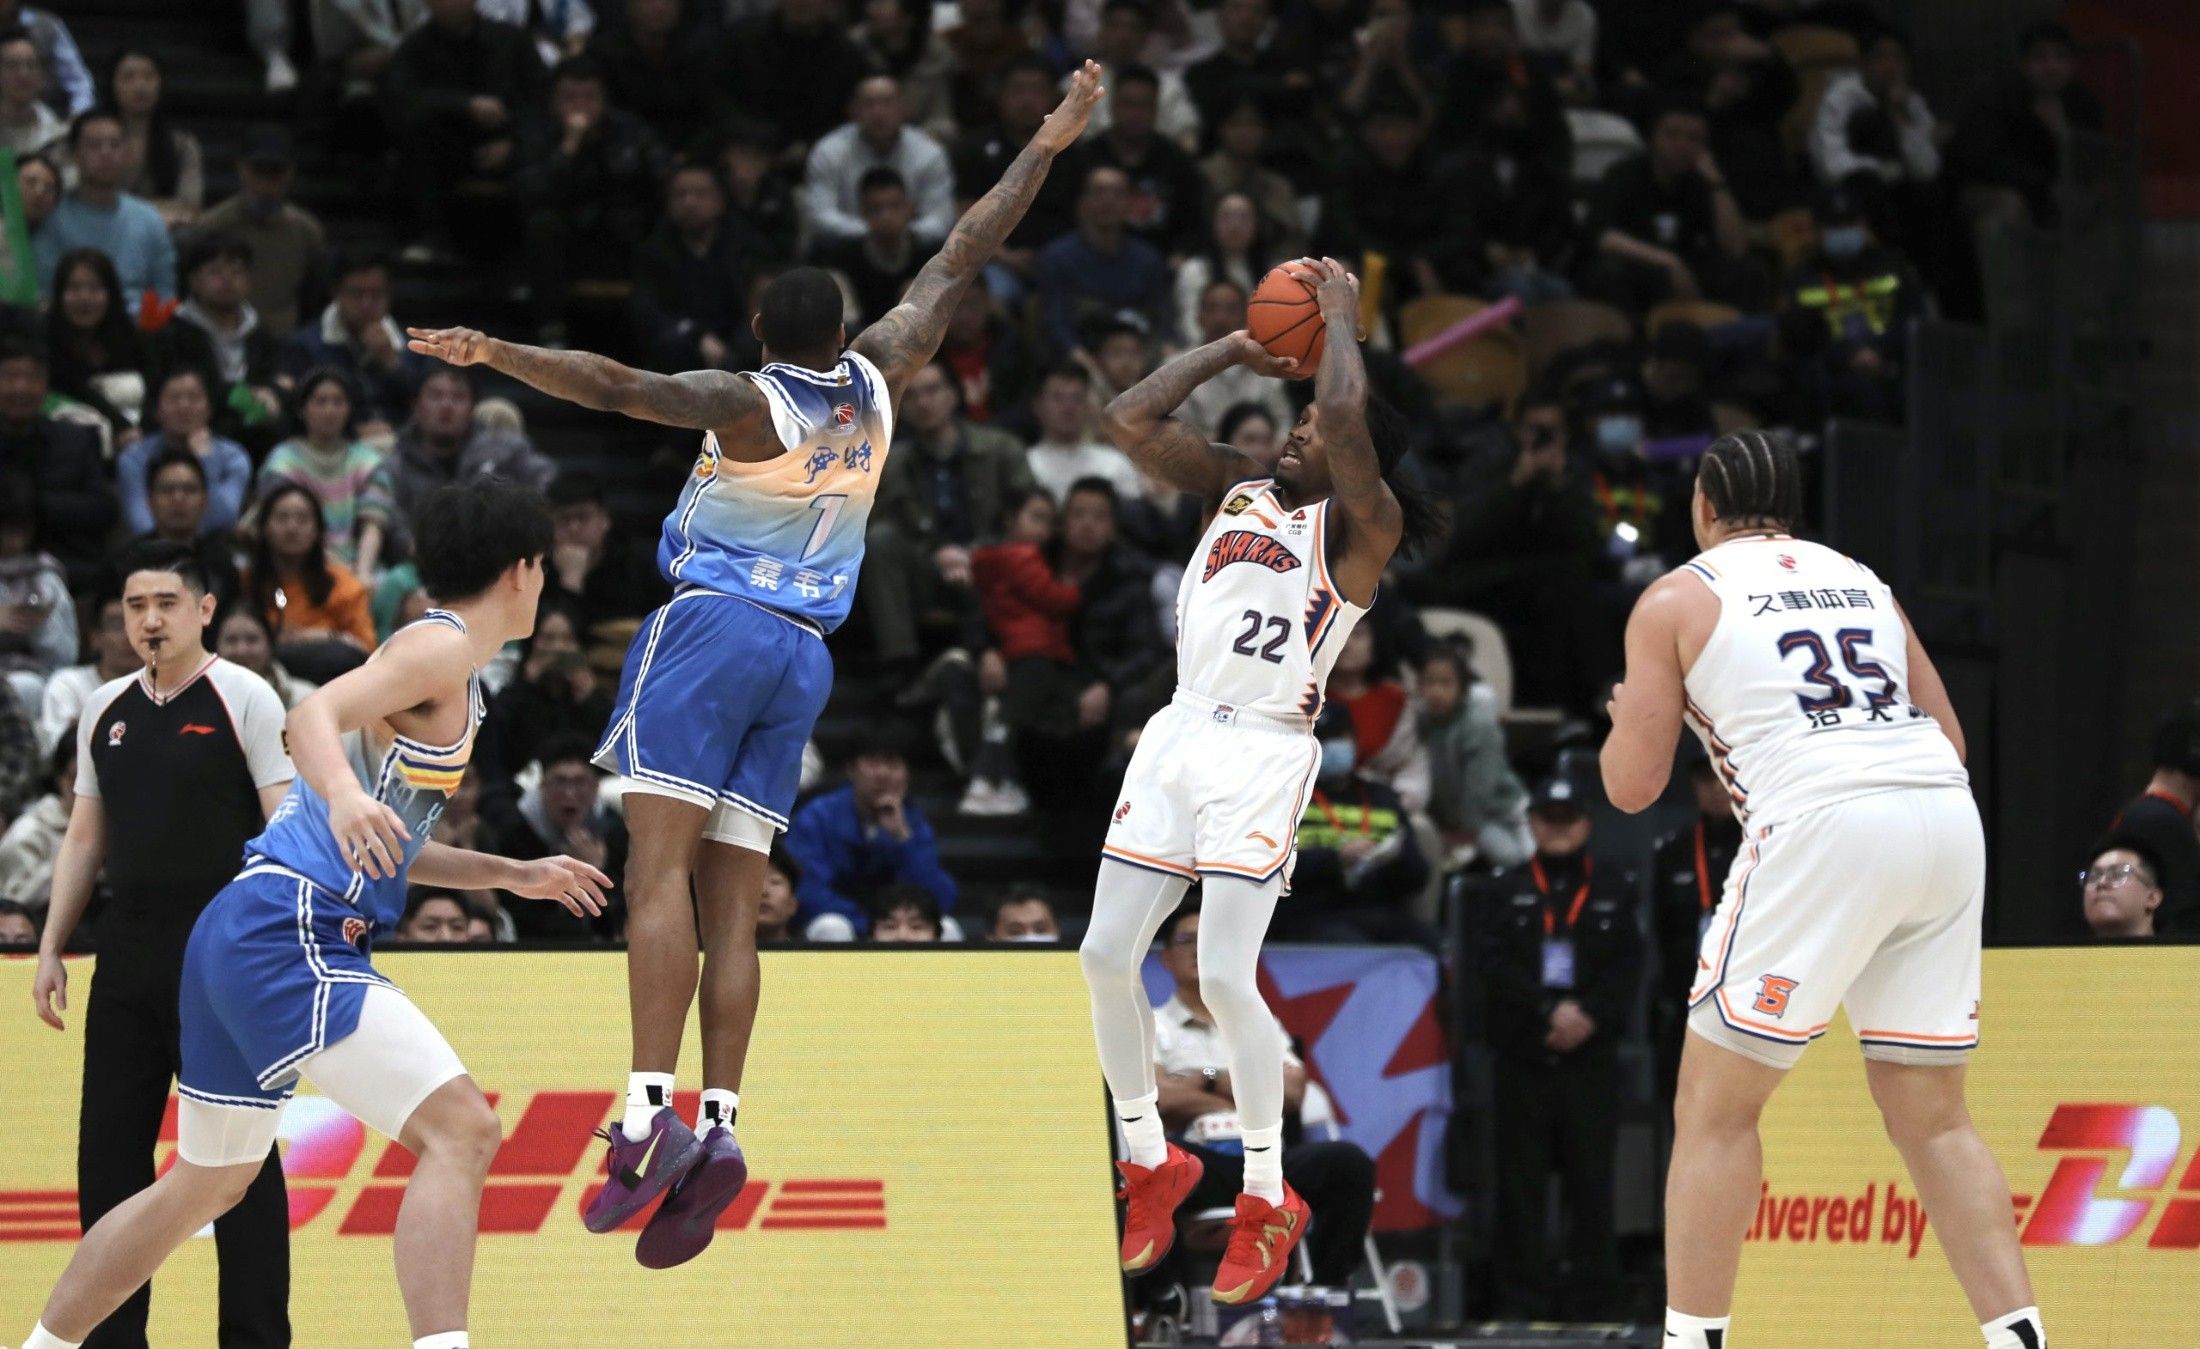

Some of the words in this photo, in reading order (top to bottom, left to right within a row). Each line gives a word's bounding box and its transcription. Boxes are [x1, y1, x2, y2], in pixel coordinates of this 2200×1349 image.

[799, 493, 848, 563] 1
[1202, 530, 1302, 584] SHARKS
[1748, 588, 1876, 617] 久事体育
[1232, 609, 1291, 664] 22
[1776, 628, 1898, 712] 35
[1745, 1180, 1876, 1243] ivered
[1881, 1181, 1927, 1260] by
